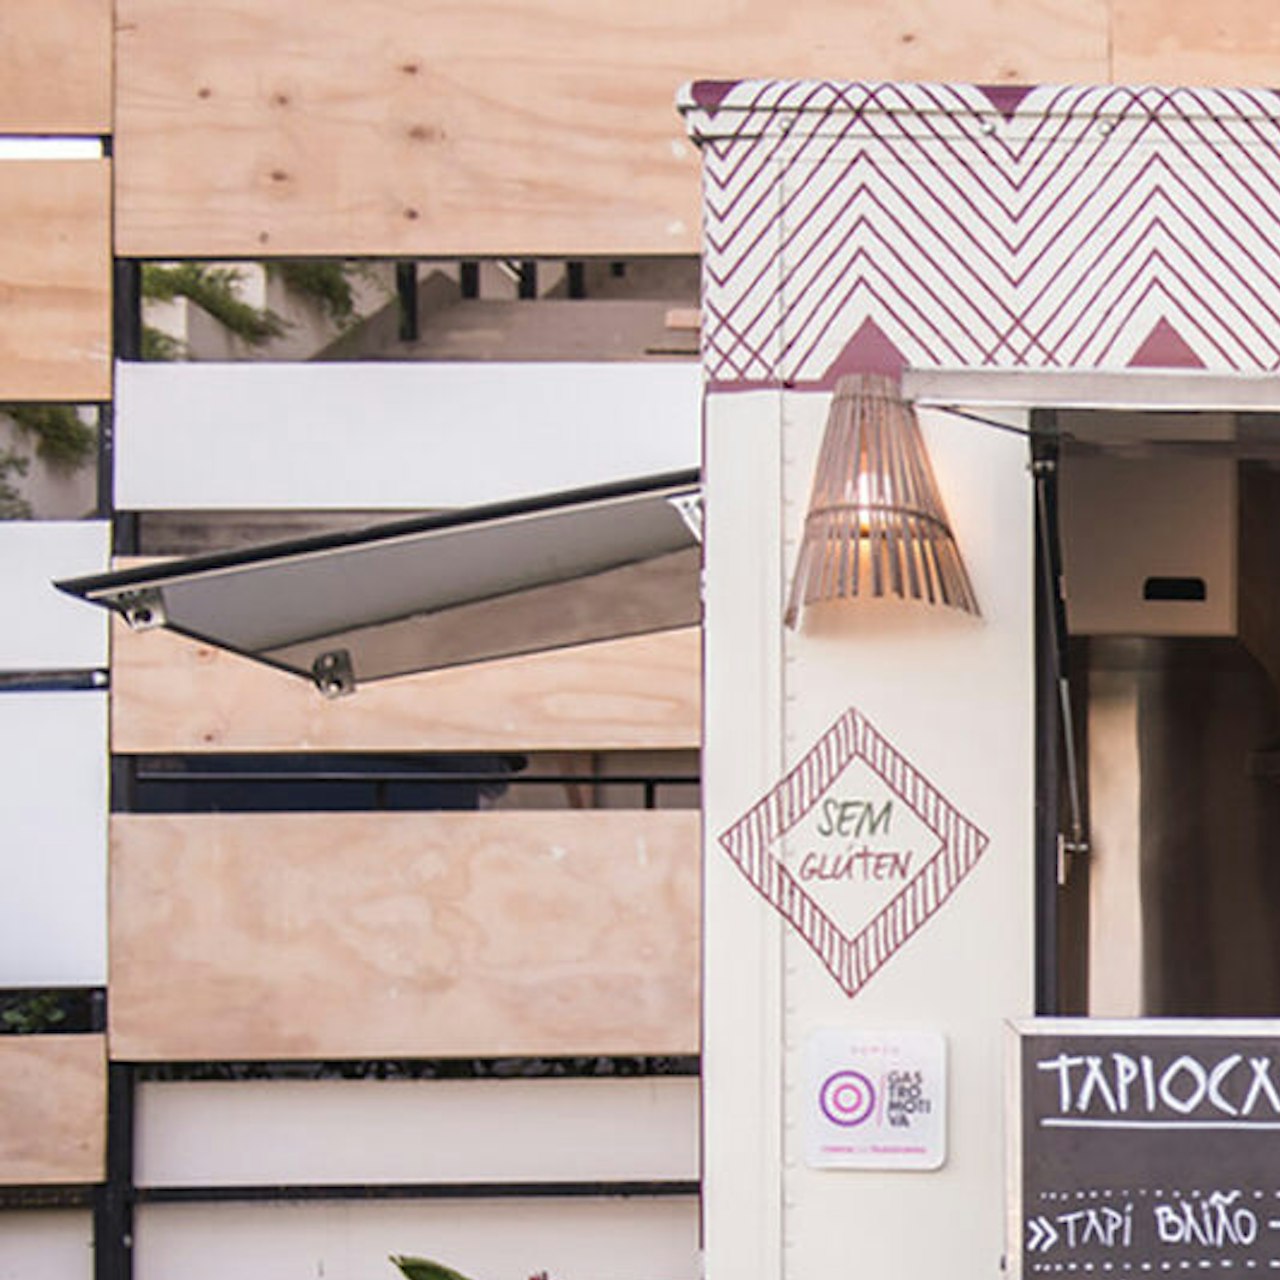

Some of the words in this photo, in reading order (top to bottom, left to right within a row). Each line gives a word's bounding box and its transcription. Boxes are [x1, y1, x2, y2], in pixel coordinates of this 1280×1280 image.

[817, 798, 892, 838] SEM
[800, 845, 912, 880] GLÚTEN
[888, 1070, 922, 1084] GAS
[1056, 1202, 1133, 1248] TAPÍ
[1154, 1190, 1258, 1247] BAIÃO
